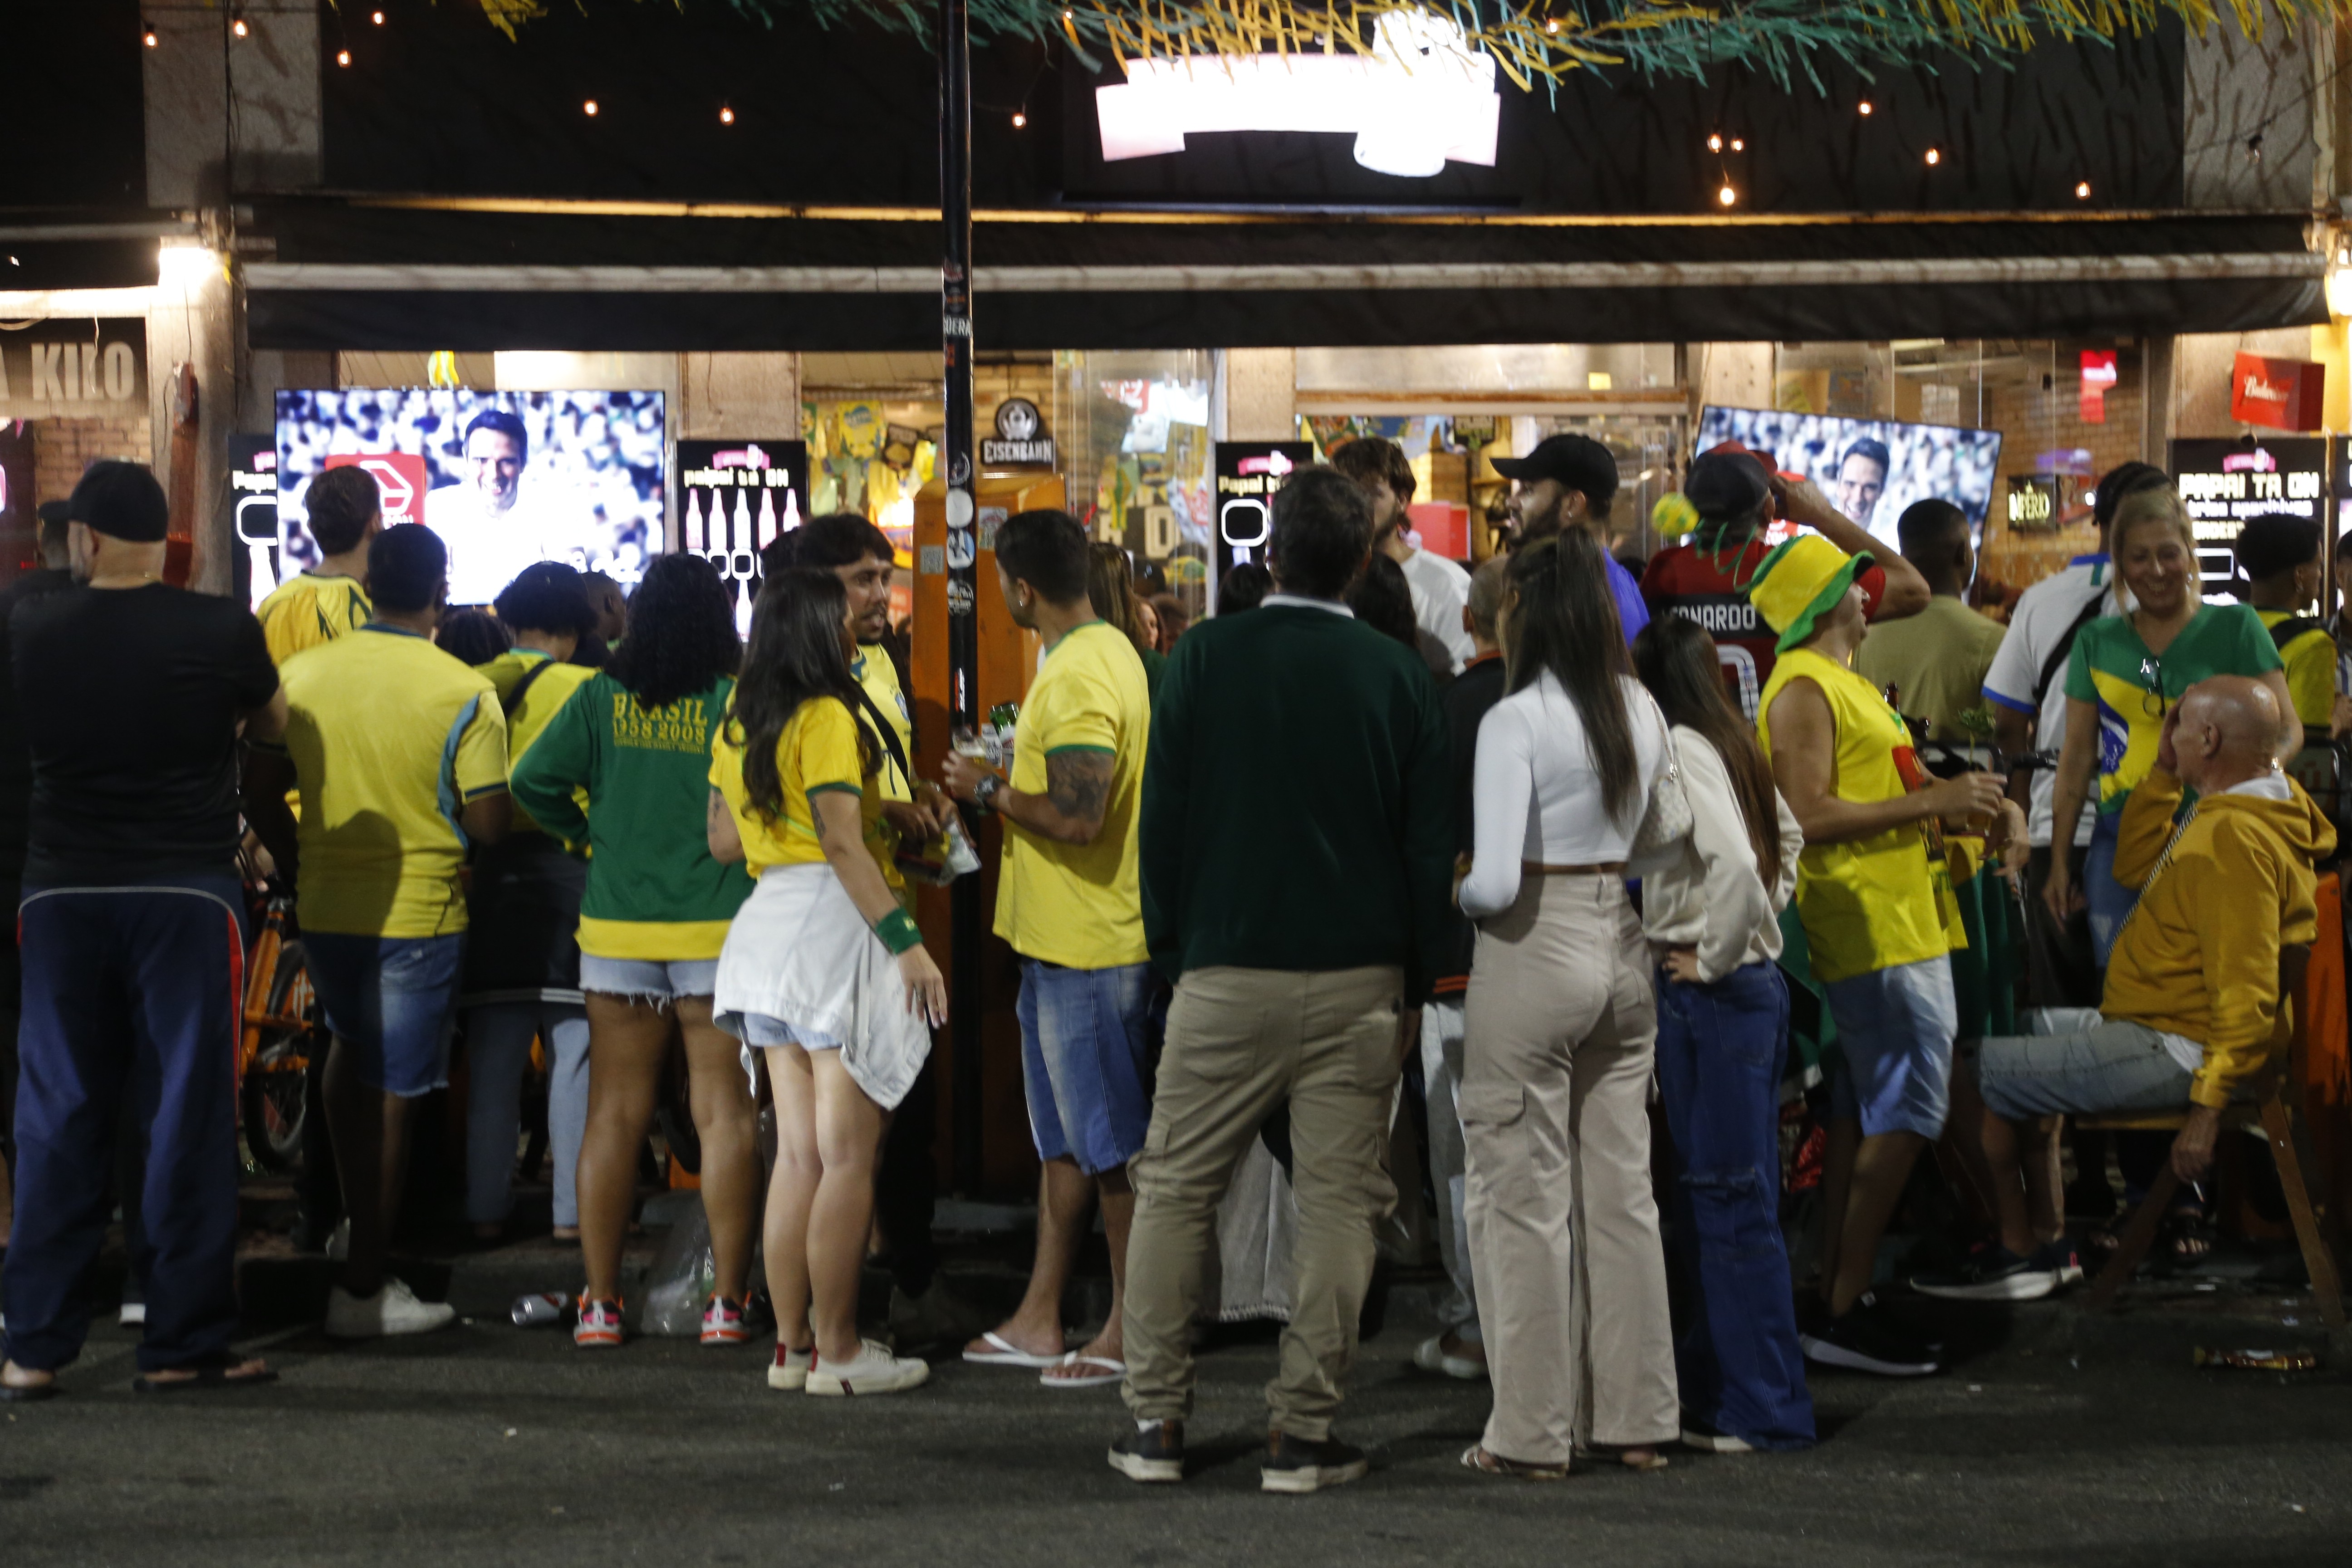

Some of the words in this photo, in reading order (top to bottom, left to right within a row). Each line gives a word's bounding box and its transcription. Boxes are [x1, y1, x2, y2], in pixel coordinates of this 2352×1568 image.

[31, 342, 134, 400] KILO
[984, 440, 1053, 463] EISENBAHN
[765, 468, 789, 487] ON
[2179, 473, 2245, 500] PAPAI
[2252, 473, 2282, 498] TA
[2288, 472, 2319, 498] ON
